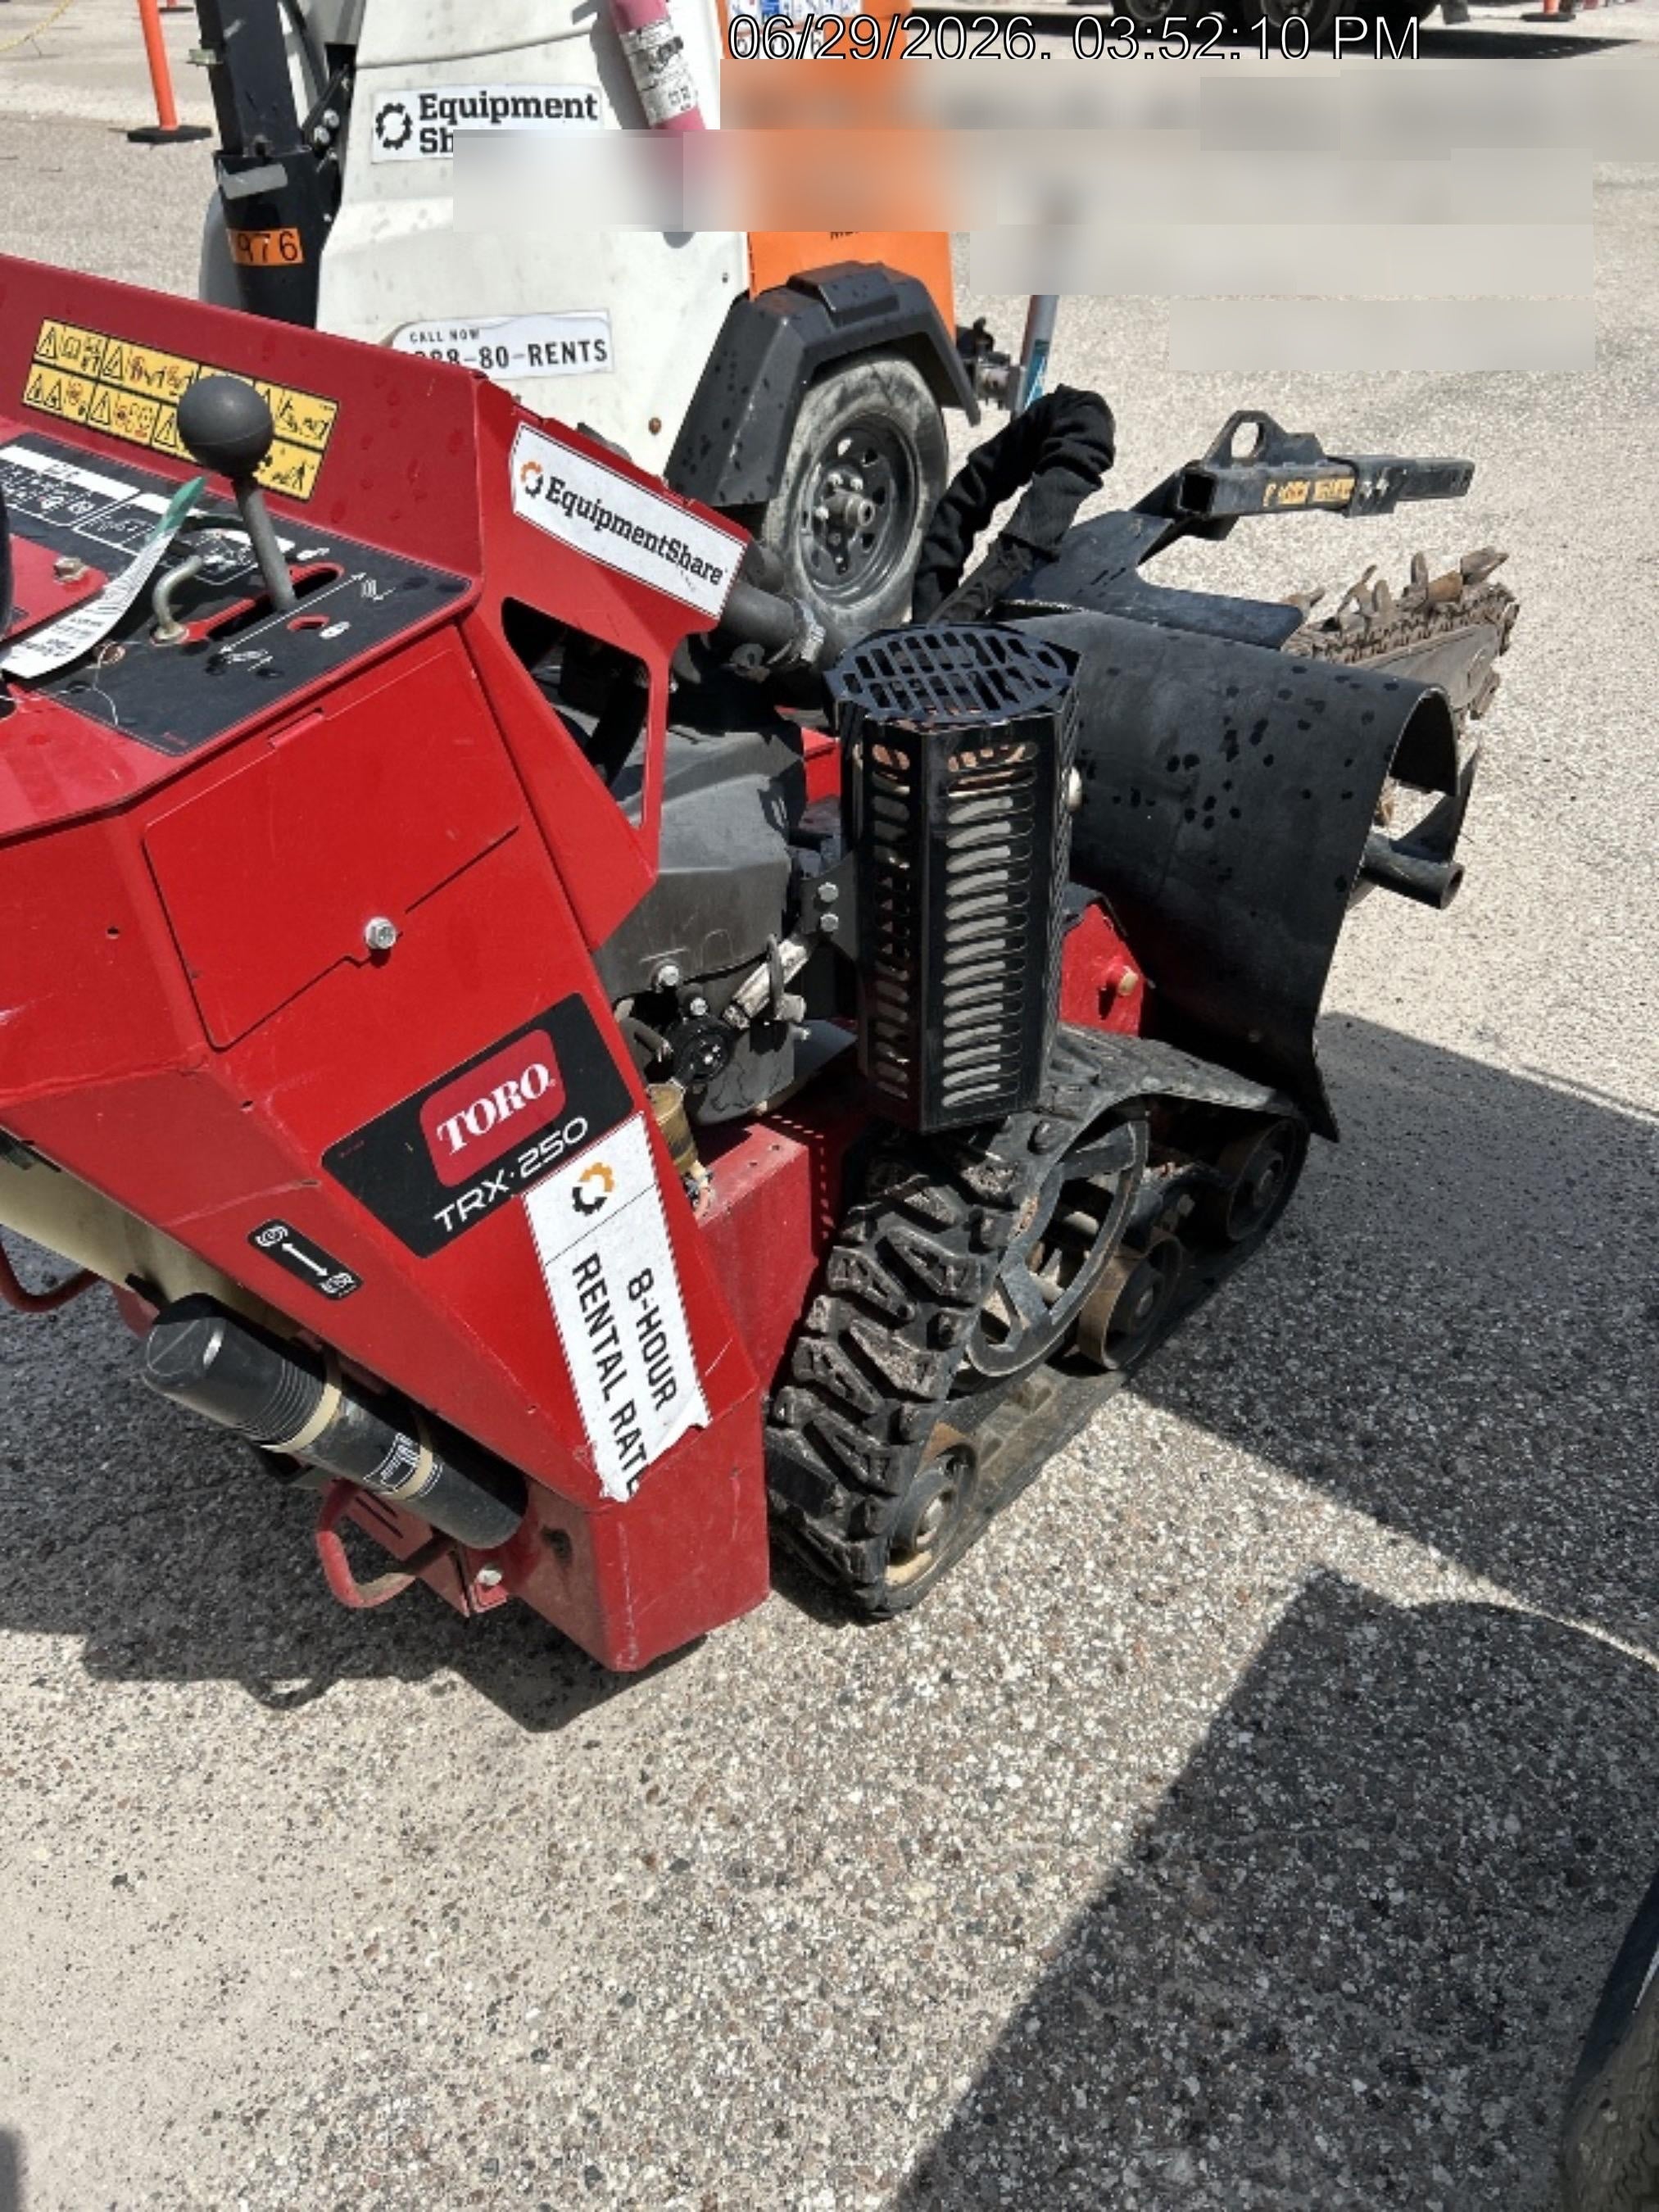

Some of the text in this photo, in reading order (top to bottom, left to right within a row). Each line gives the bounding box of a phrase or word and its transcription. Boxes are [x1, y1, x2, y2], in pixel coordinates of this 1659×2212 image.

[418, 90, 599, 125] Equipment
[410, 329, 480, 343] CALL NOW
[545, 476, 726, 586] EquipmentShare
[436, 1063, 551, 1156] TORO
[572, 1252, 628, 1402] RENTAL
[627, 1267, 678, 1412] 8-HOUR
